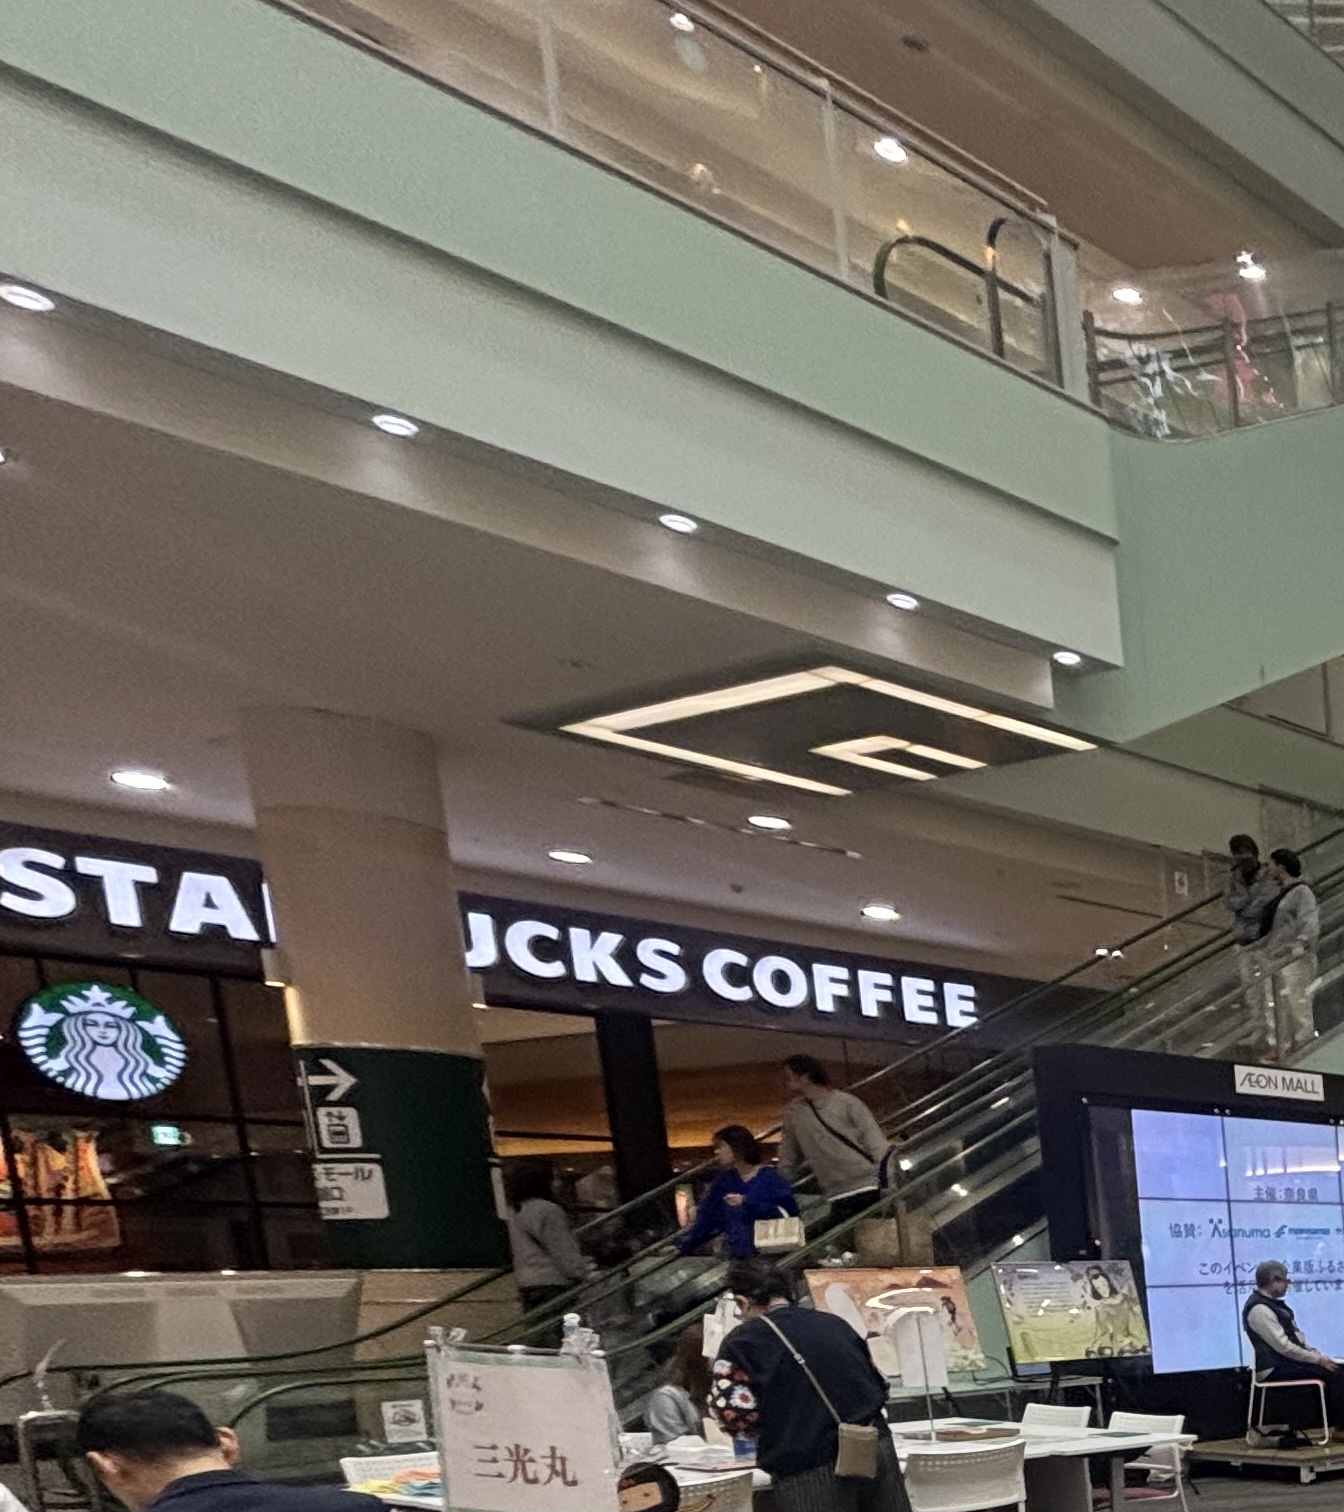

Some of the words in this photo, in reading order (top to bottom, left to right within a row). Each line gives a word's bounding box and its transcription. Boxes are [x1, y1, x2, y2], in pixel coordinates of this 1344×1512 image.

[702, 948, 979, 1029] COFFEE
[1282, 1076, 1319, 1094] MALL
[473, 1443, 579, 1487] 三光丸
